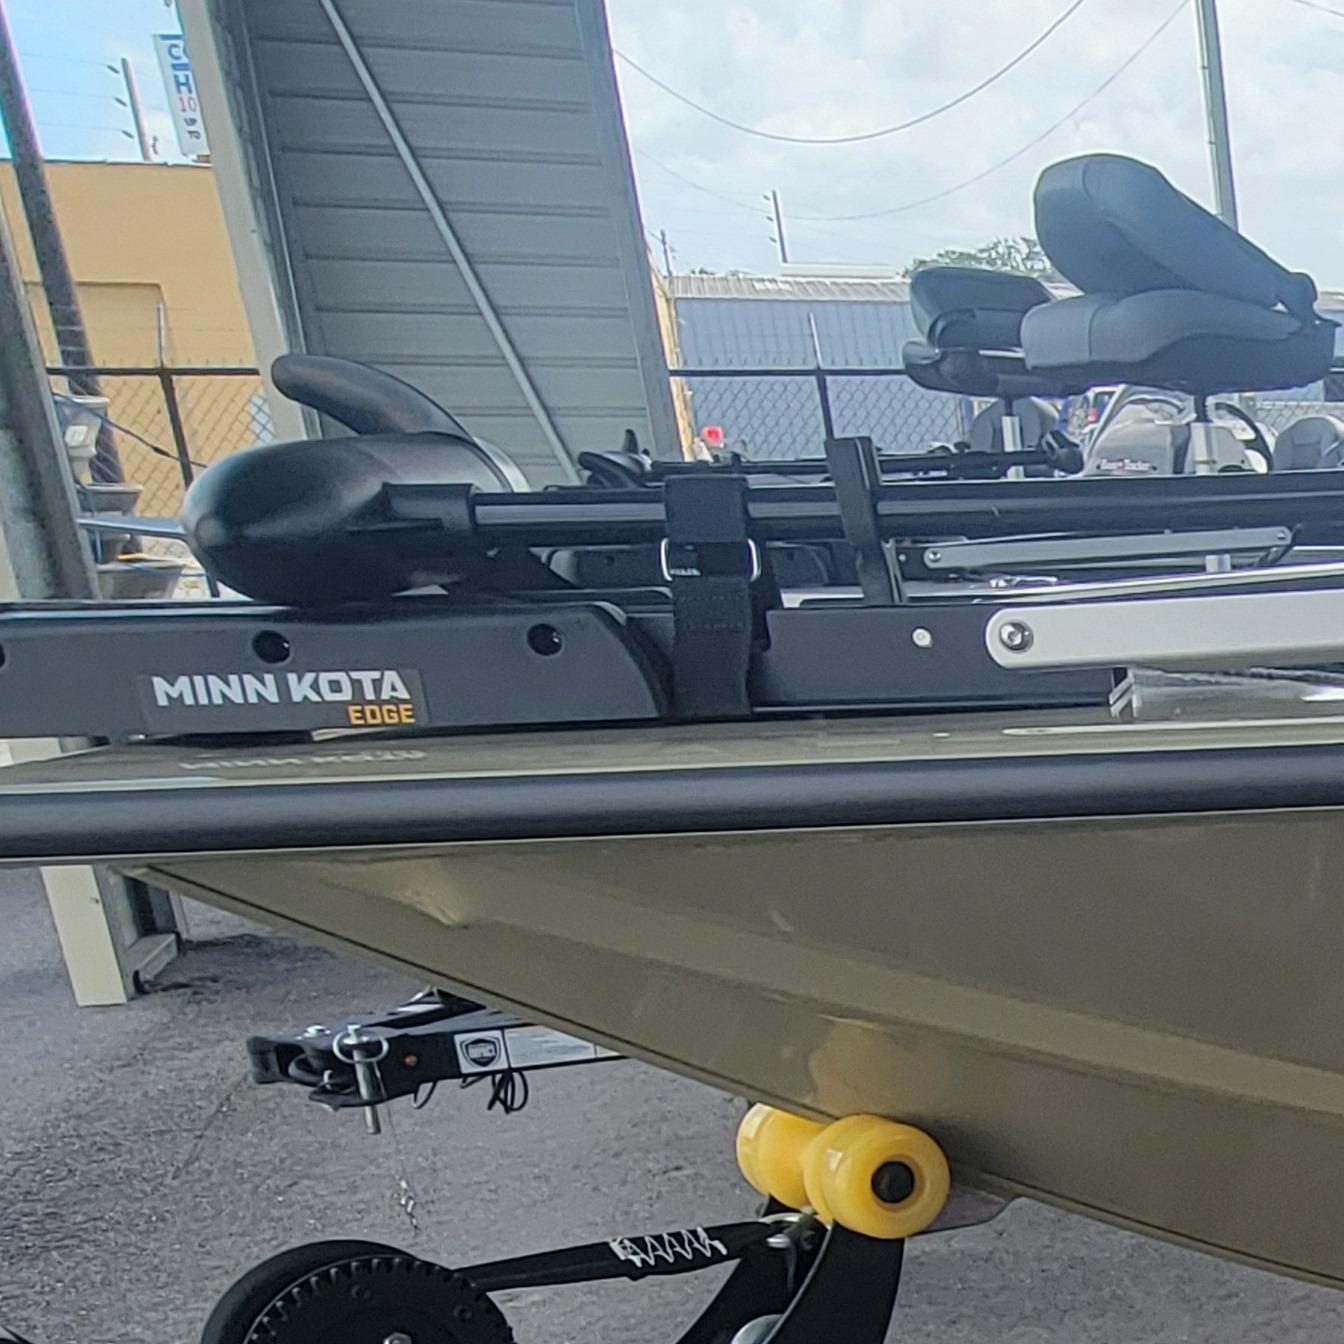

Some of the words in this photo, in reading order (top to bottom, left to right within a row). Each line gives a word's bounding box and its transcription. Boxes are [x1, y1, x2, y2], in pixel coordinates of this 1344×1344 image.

[152, 673, 280, 706] MINN
[286, 670, 411, 702] KOTA
[348, 704, 416, 725] EDGE
